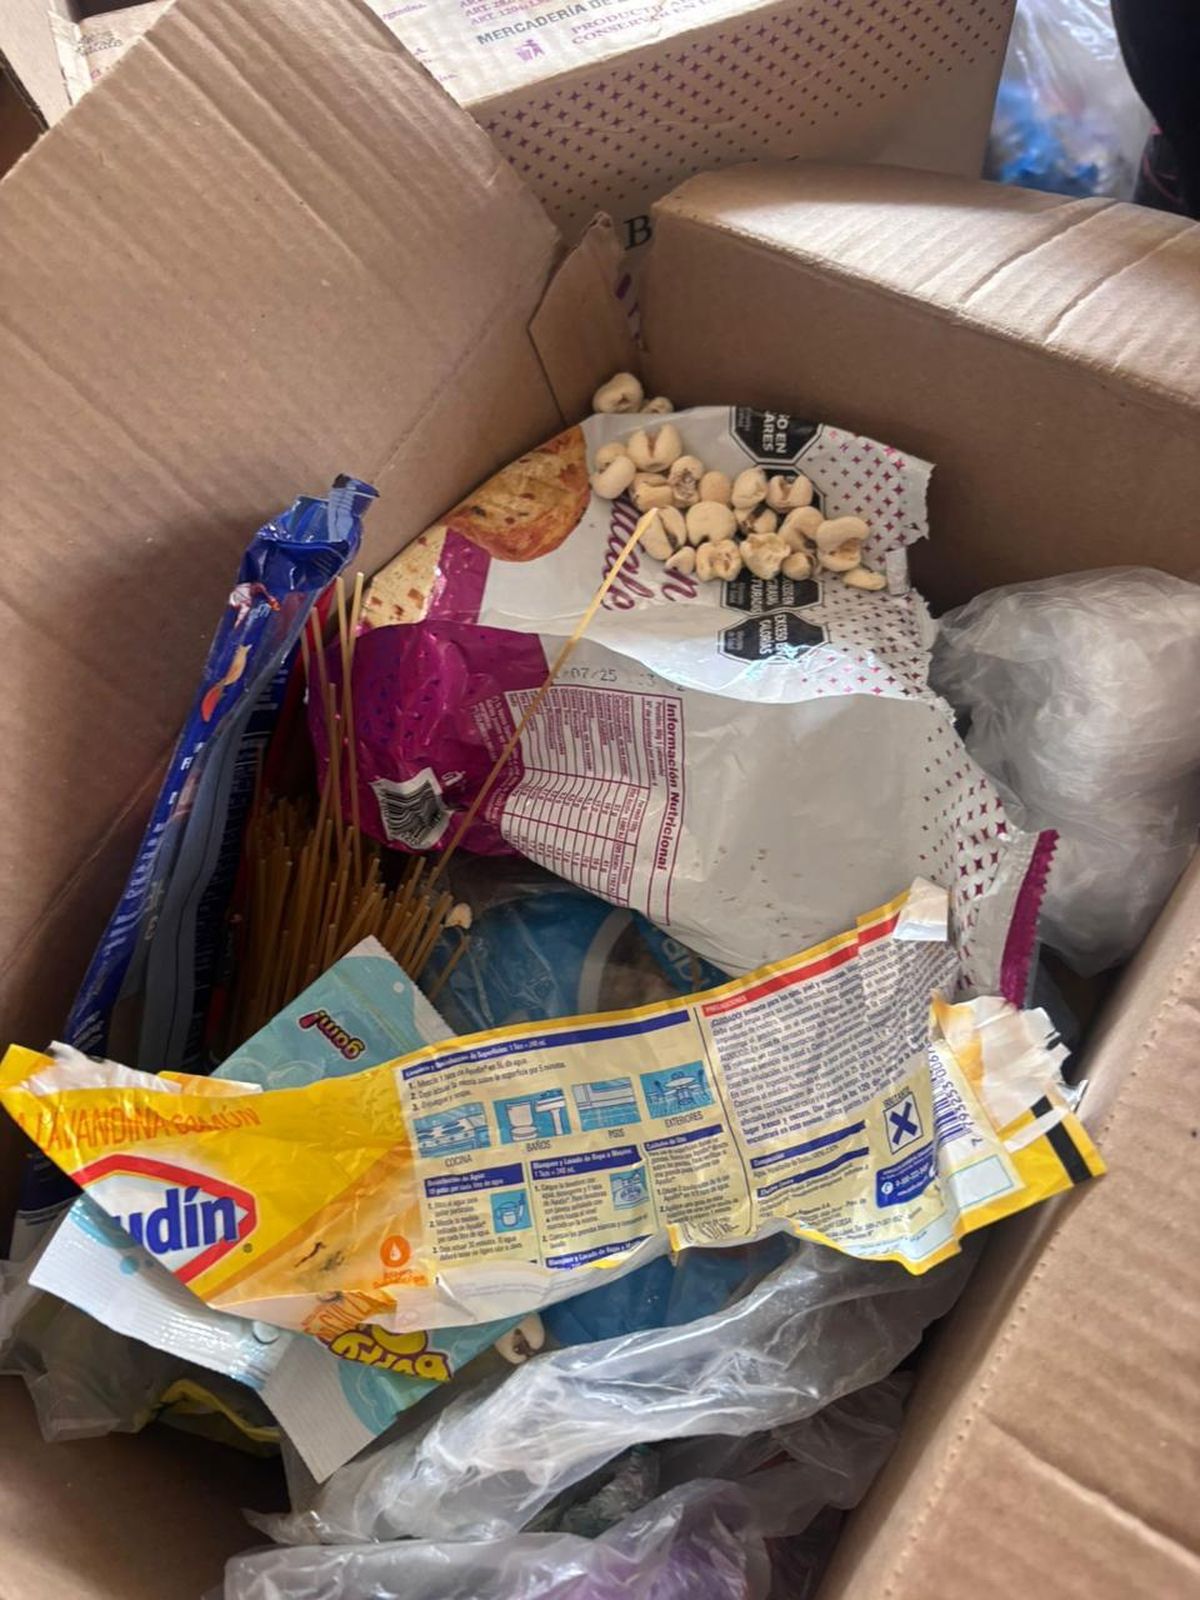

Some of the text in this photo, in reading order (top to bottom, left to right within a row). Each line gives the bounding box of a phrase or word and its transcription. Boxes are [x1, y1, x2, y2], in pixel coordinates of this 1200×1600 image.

[476, 4, 587, 45] MERCADERÍA
[775, 433, 787, 454] EN
[657, 703, 682, 871] Información Nutricional
[444, 1155, 473, 1168] COCINA
